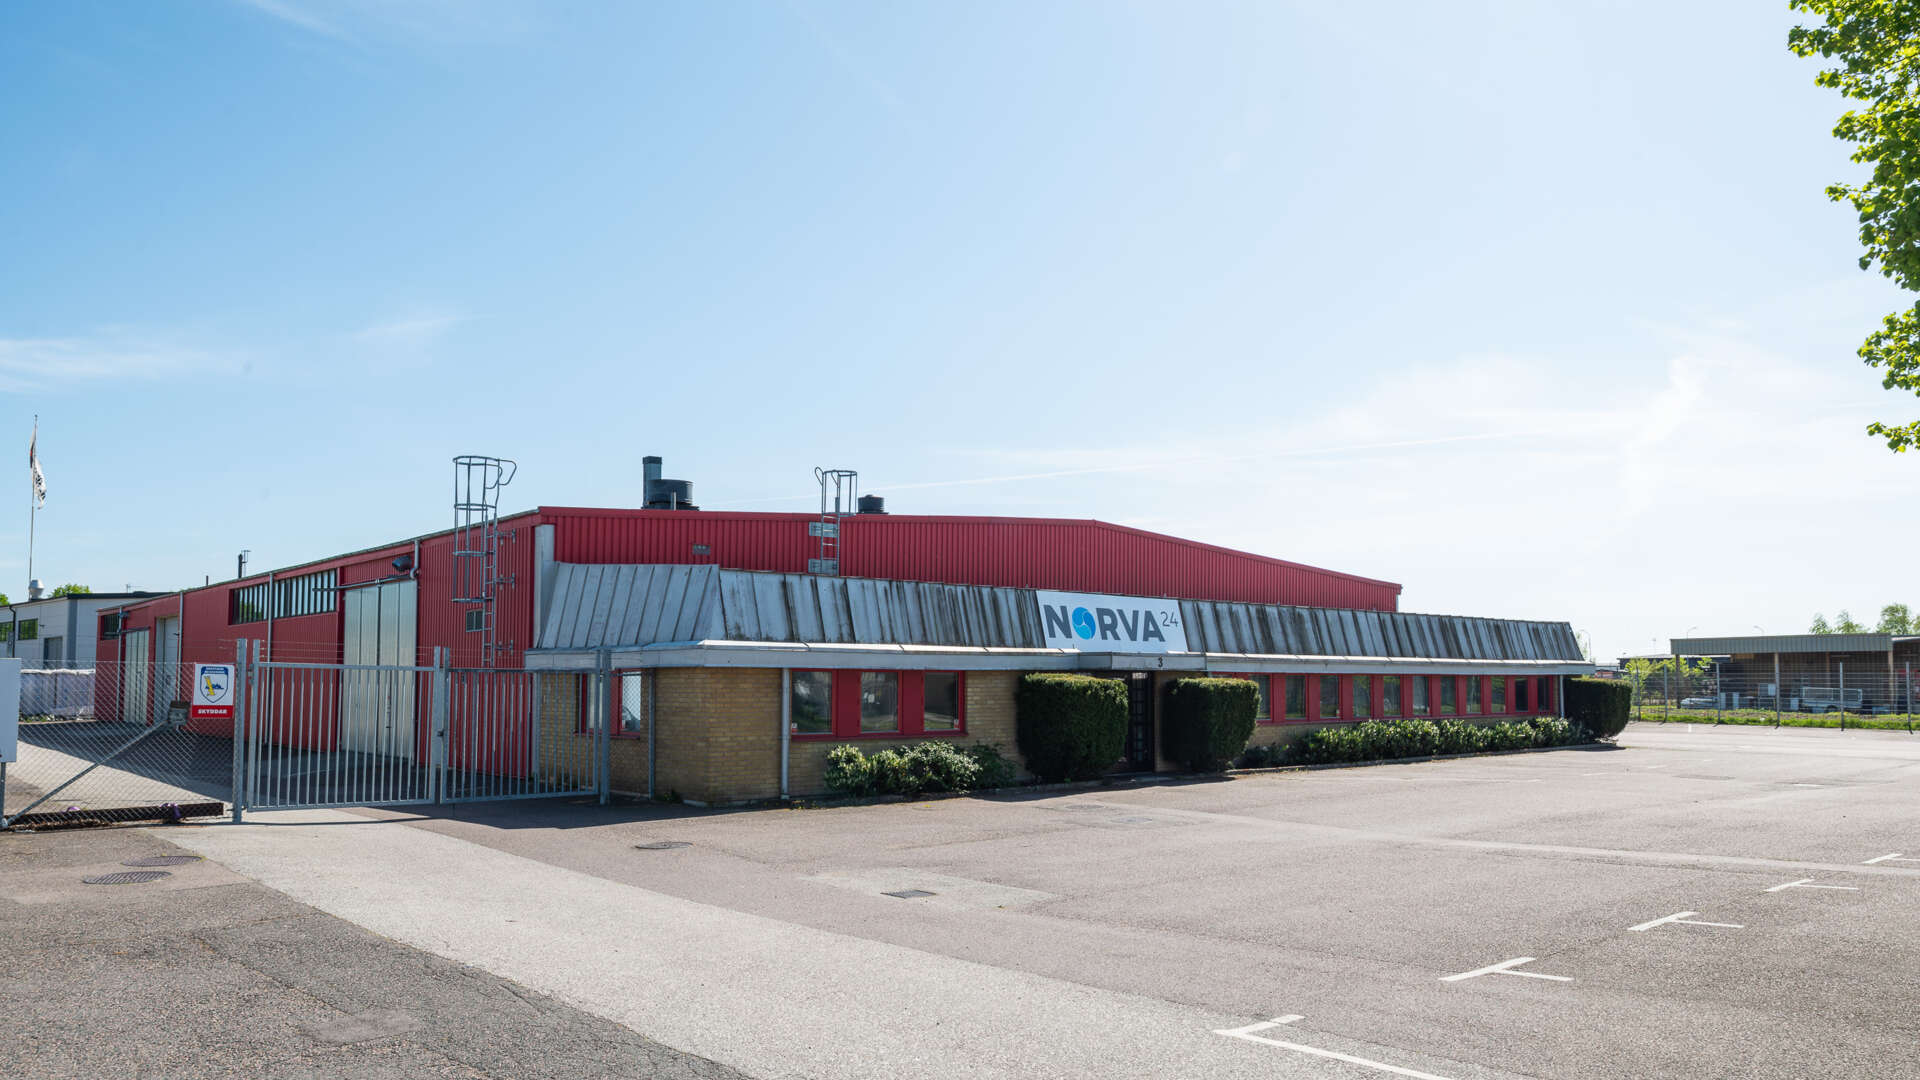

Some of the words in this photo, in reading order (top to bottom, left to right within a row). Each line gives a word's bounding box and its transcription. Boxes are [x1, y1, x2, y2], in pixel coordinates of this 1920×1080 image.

[1043, 604, 1166, 642] NORVA
[1160, 611, 1178, 627] 24
[1158, 655, 1163, 668] 3
